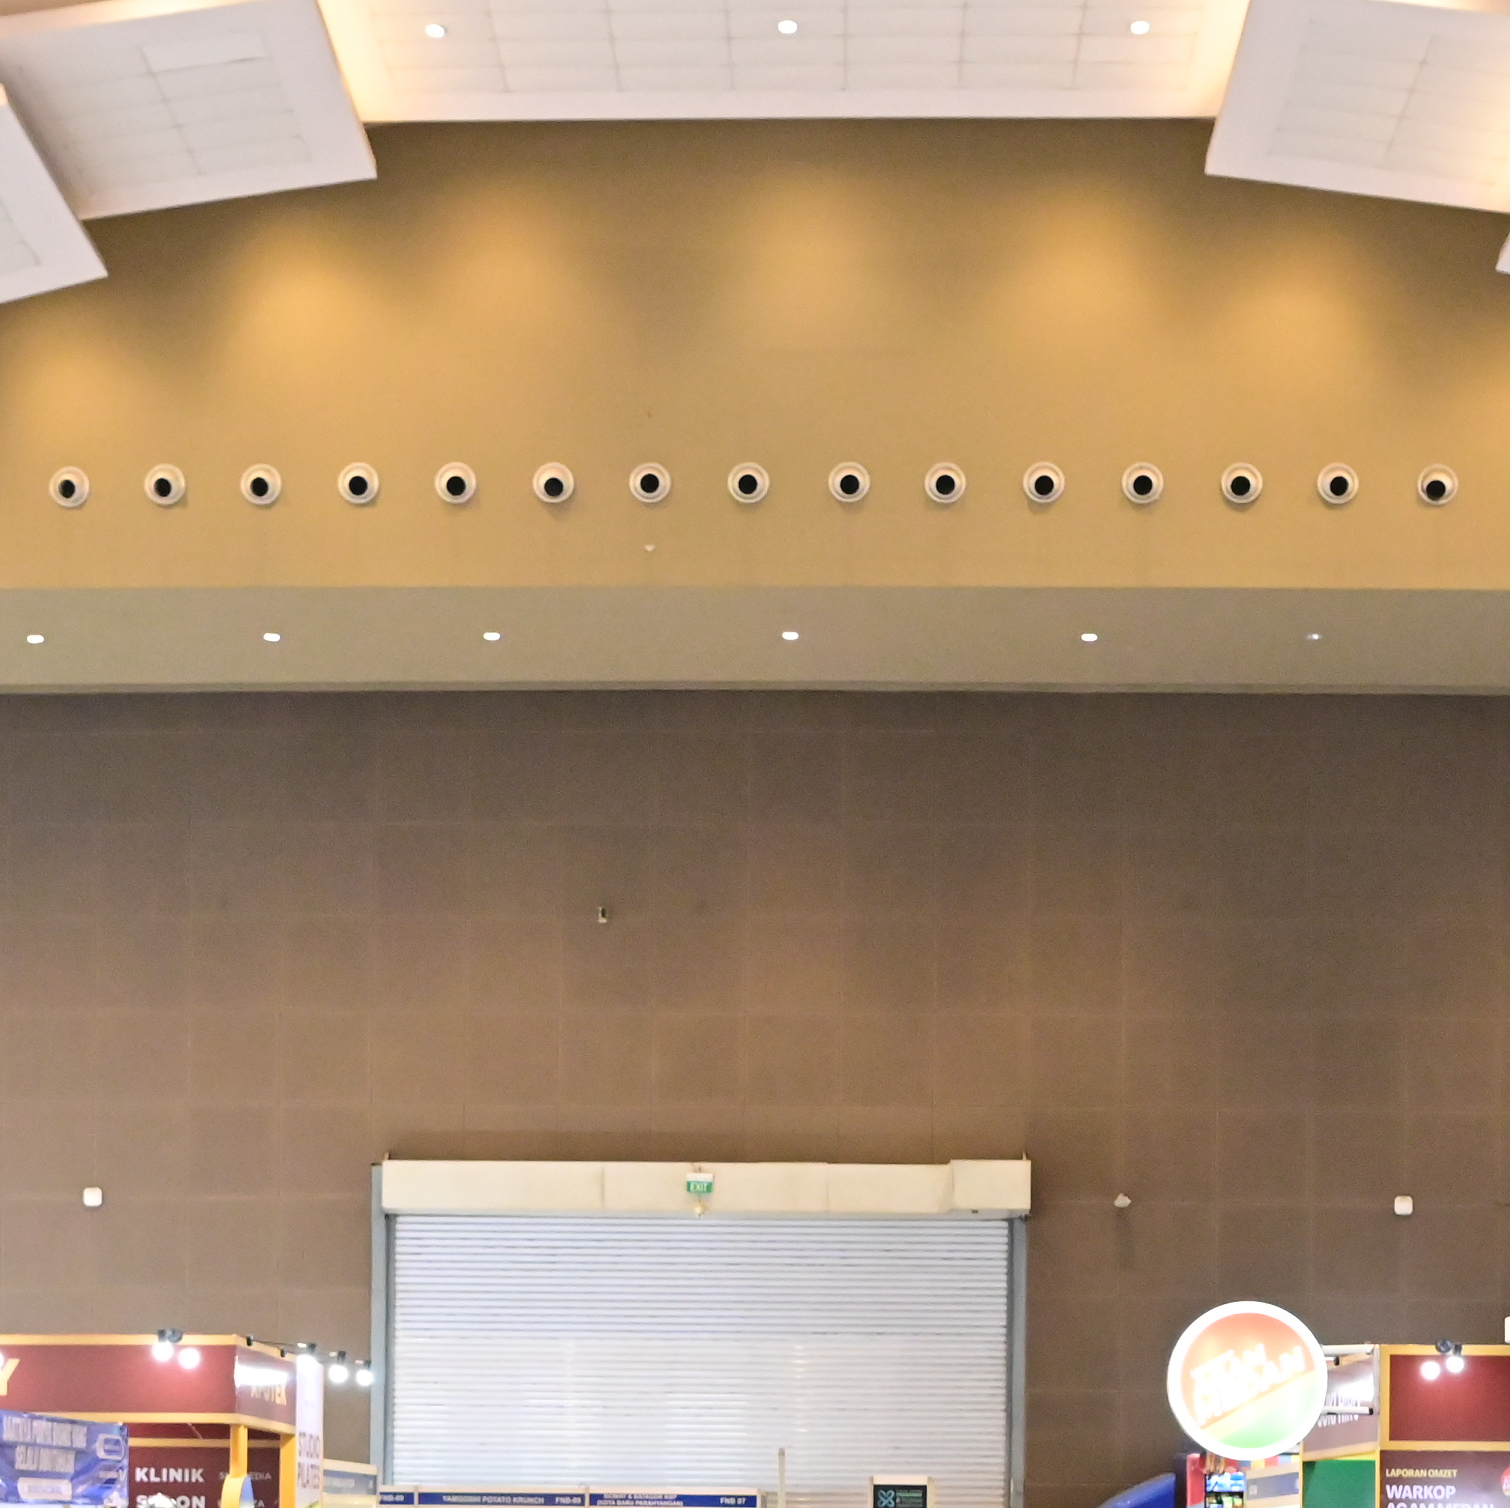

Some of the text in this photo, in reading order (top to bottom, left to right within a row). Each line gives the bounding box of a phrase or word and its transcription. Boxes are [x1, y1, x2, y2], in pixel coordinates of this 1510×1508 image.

[135, 1467, 205, 1483] KLINIK
[1385, 1469, 1458, 1478] LAPORAN OMZET
[1385, 1485, 1457, 1500] WARKOP
